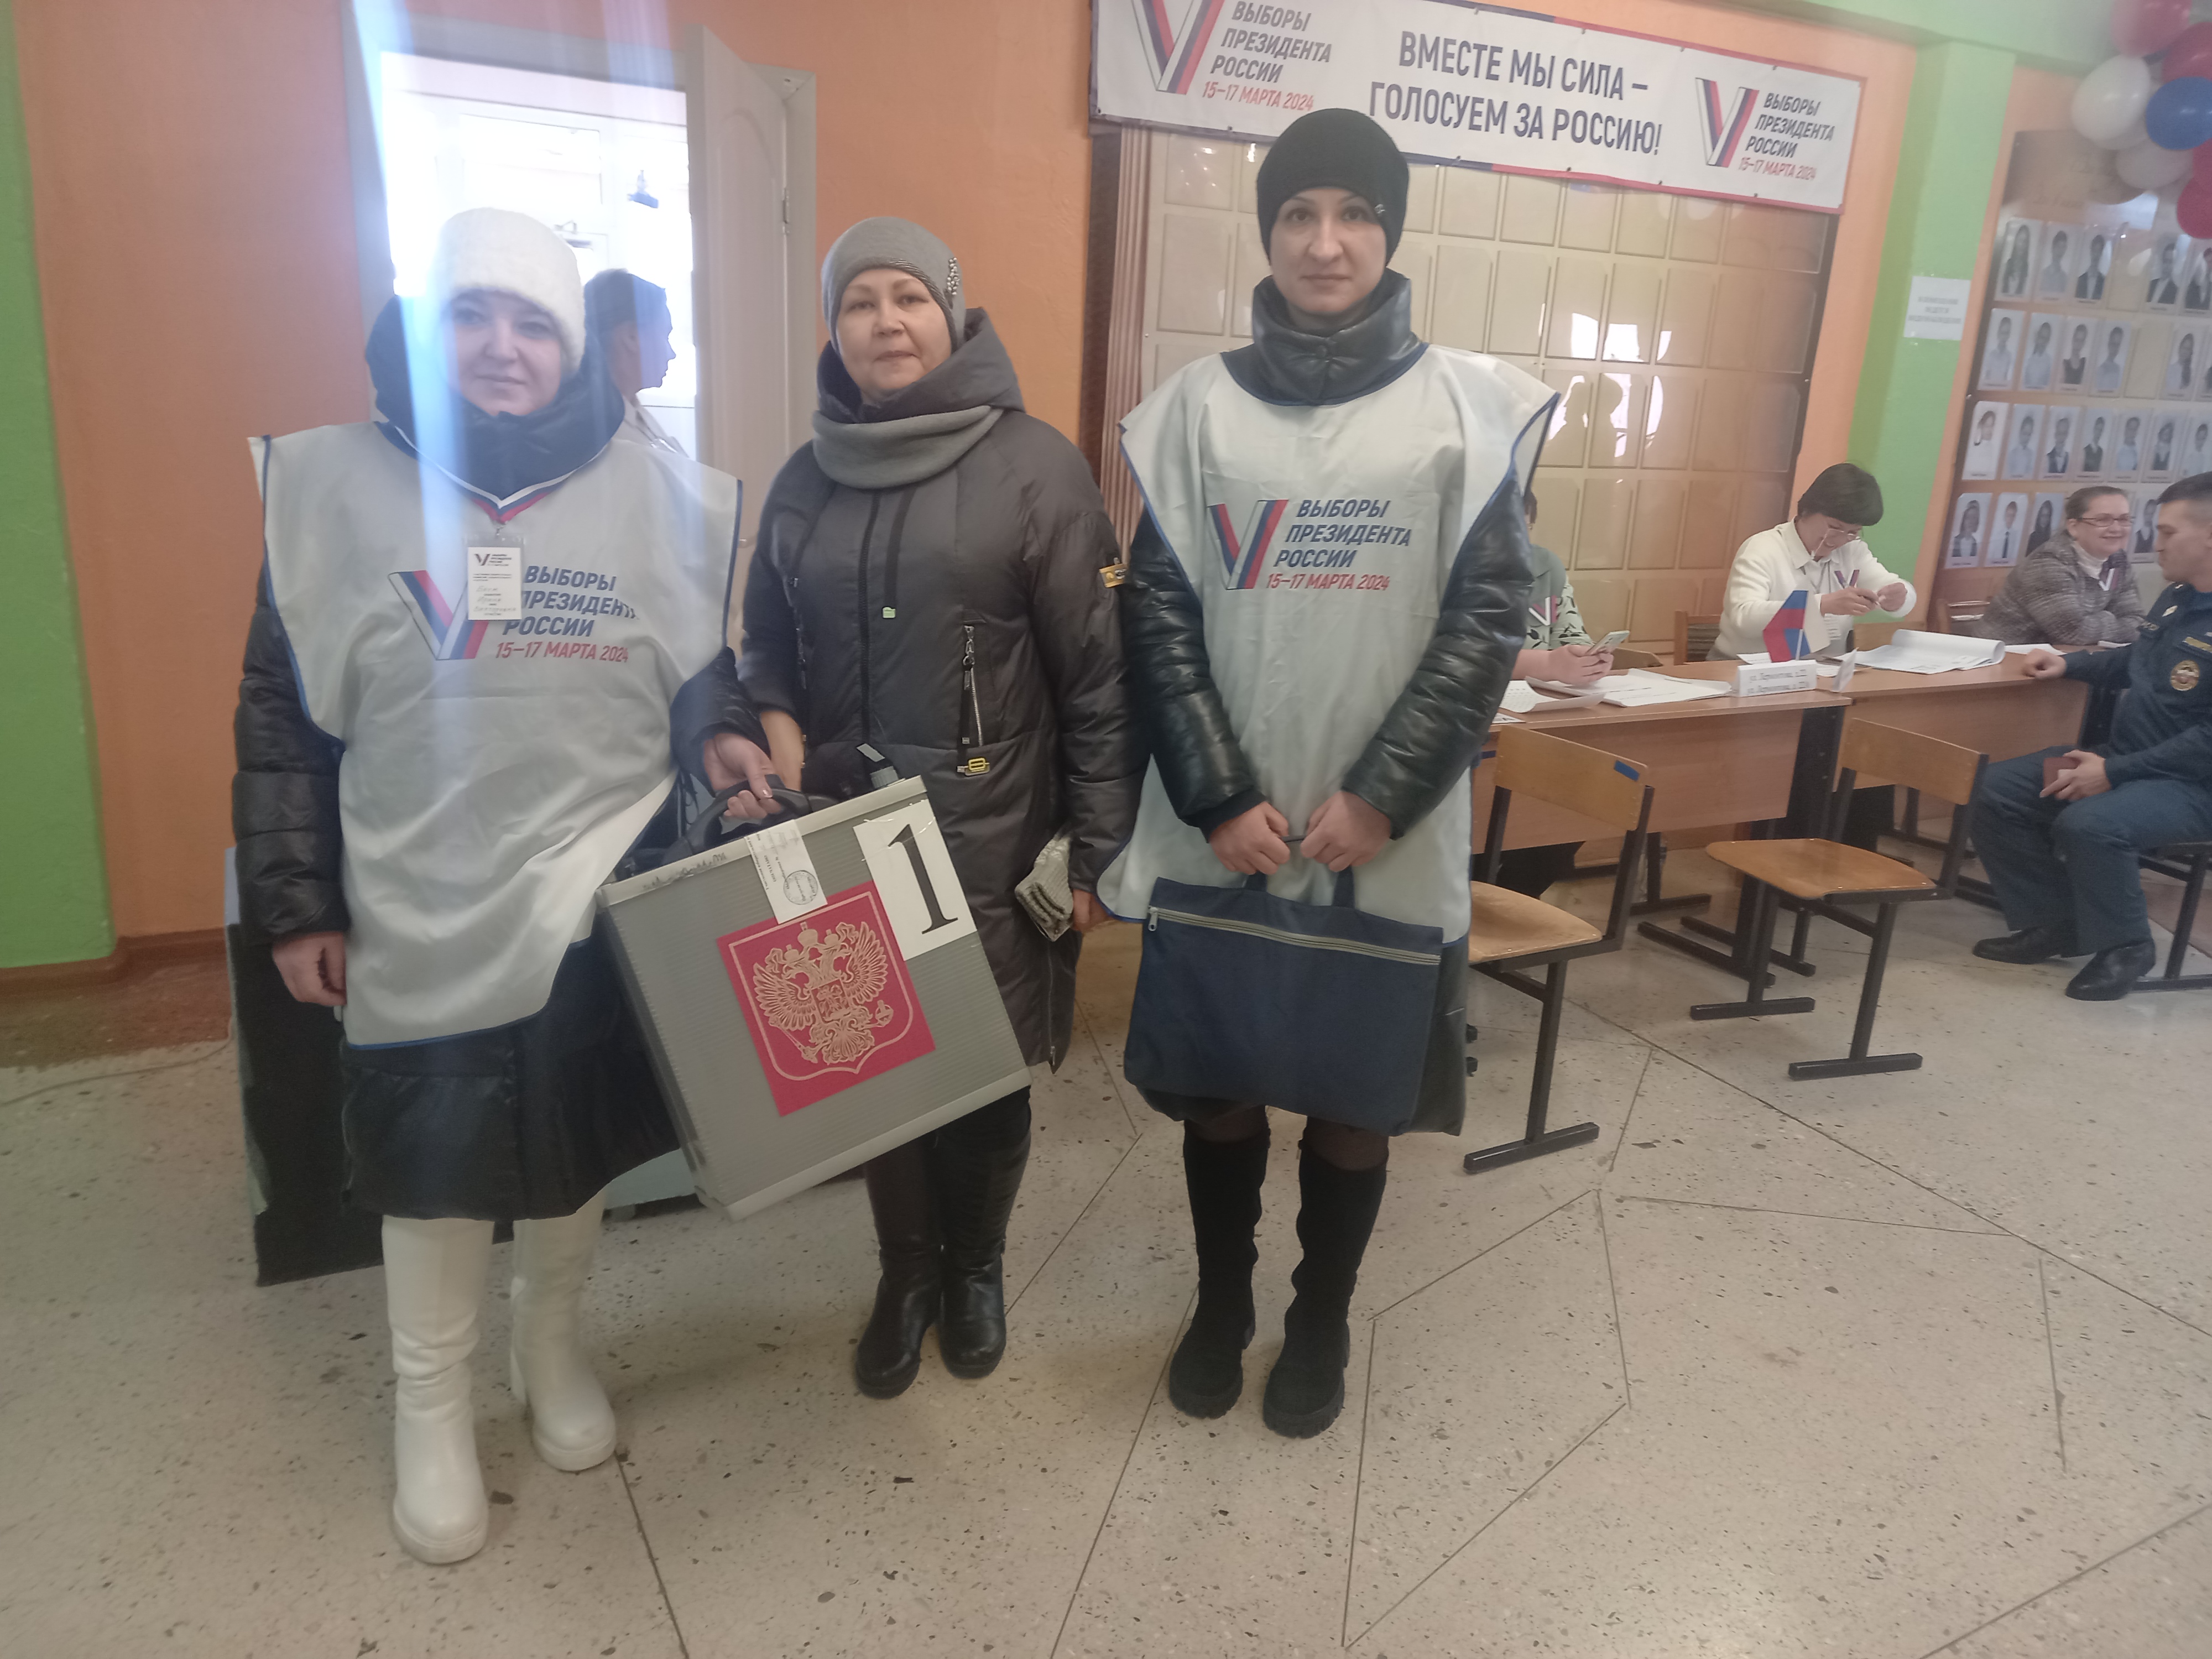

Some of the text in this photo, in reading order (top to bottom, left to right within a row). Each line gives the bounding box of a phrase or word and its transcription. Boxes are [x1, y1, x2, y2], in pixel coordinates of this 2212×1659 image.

[1232, 1, 1311, 32] ВЫБОРЫ
[1220, 28, 1332, 62] ПРЕЗИДЕНТА
[1210, 54, 1284, 84] РОССИИ
[1399, 30, 1503, 81] ВМЕСТЕ
[1509, 49, 1555, 88] МЫ
[1561, 58, 1624, 100] СИЛА
[1239, 86, 1282, 107] МАРТА
[1282, 92, 1314, 111] 2024
[1763, 92, 1821, 116] ВЫБОРЫ
[1369, 81, 1663, 155] ГОЛОСУЕМ ЗА РОССИЮ!
[1754, 114, 1835, 141] ПРЕЗИДЕНТА
[1745, 135, 1798, 158] РОССИИ
[1762, 161, 1796, 178] МАРТА
[1296, 499, 1391, 518] ВЫБОРЫ
[1285, 524, 1412, 546] ПРЕЗИДЕНТА
[1273, 549, 1358, 568] РОССИИ
[523, 566, 617, 591] ВЫБОРЫ
[1305, 573, 1355, 589] МАРТА
[1356, 575, 1390, 591] 2024
[502, 616, 594, 637] РОССИИ
[544, 641, 597, 659] МАРТА
[888, 823, 958, 935] 1
